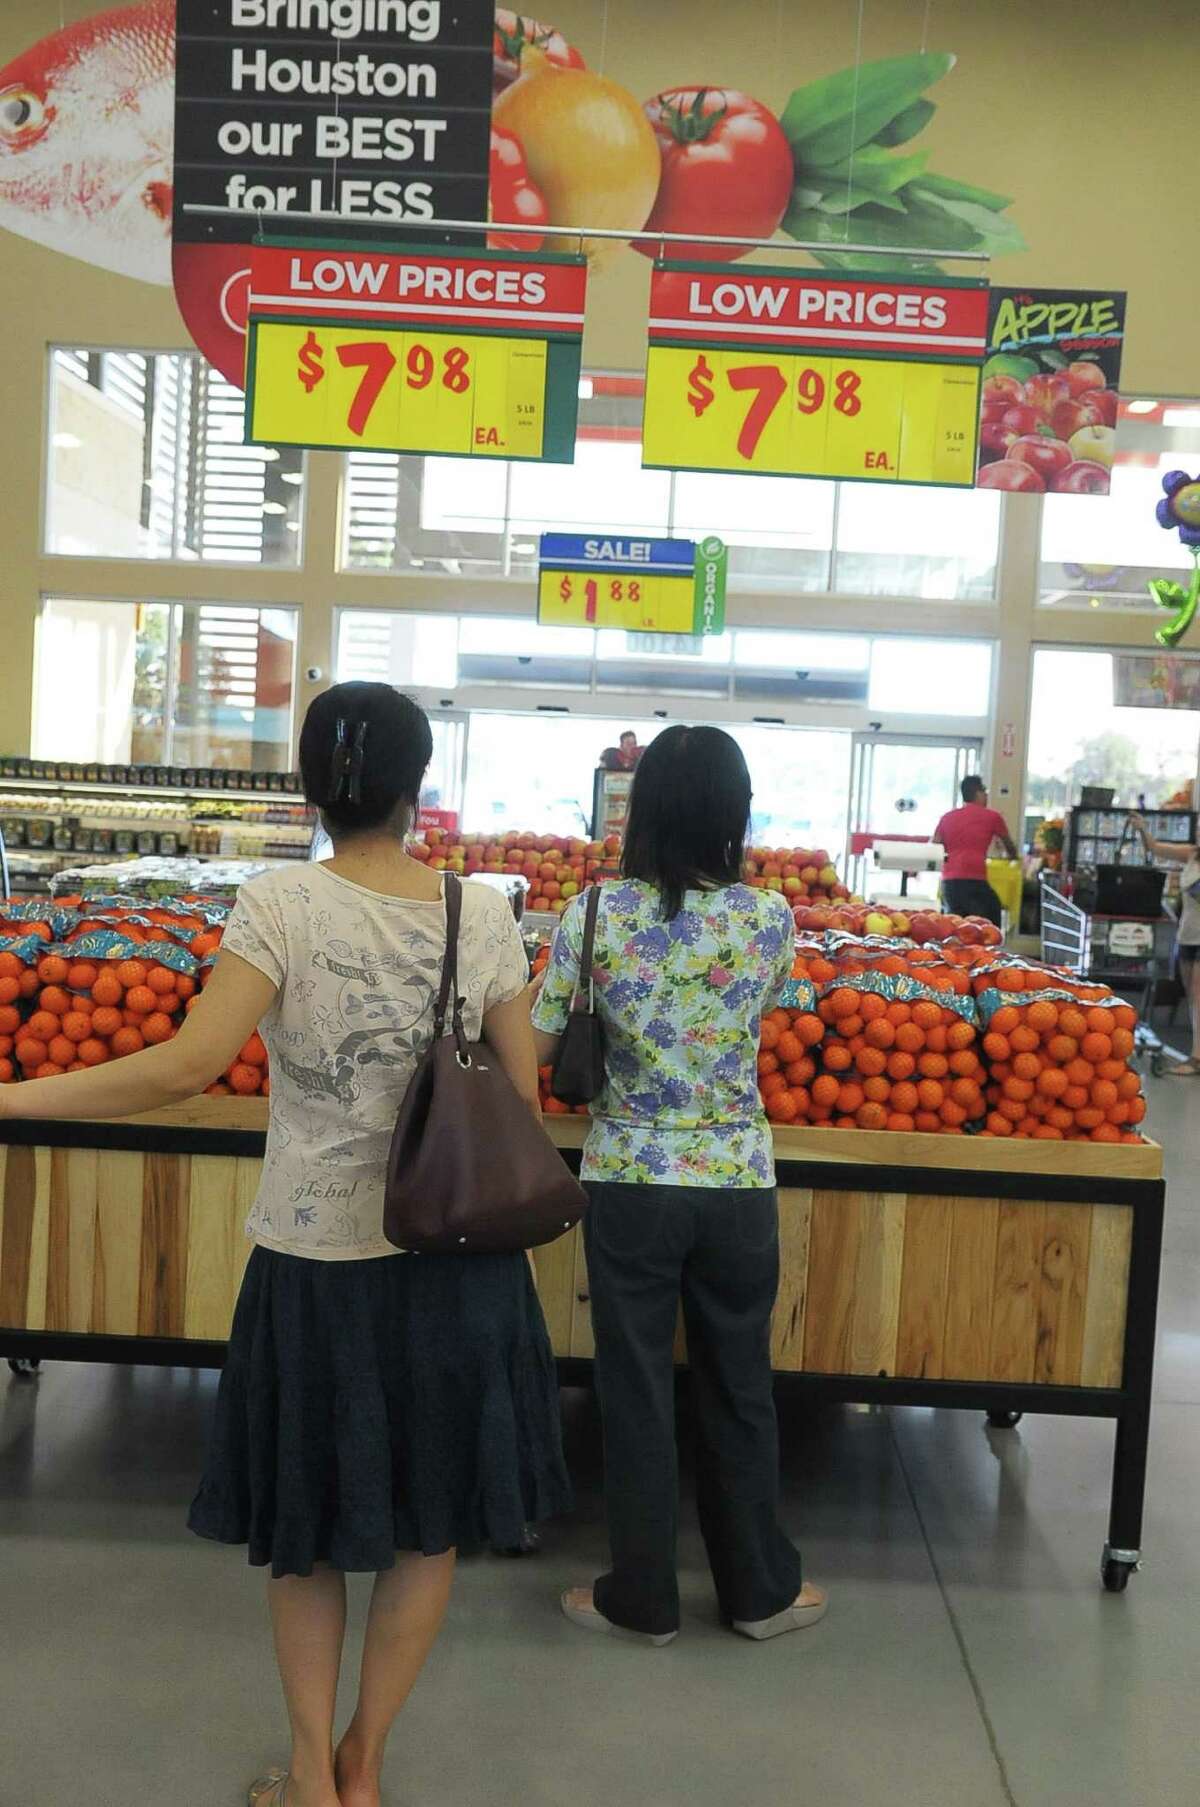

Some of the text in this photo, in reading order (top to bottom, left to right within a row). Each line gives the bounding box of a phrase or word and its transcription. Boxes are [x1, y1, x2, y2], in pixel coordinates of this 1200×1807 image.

[231, 0, 440, 41] Bringing
[231, 48, 437, 97] Houston
[218, 115, 447, 161] our BEST
[225, 174, 434, 219] for LESS
[290, 258, 546, 304] LOW PRICES
[689, 281, 946, 328] LOW PRICES
[992, 298, 1119, 348] APPLE
[475, 426, 506, 446] EA.
[865, 451, 895, 471] EA.
[584, 540, 651, 562] SALE!
[703, 562, 718, 636] ORGANIC
